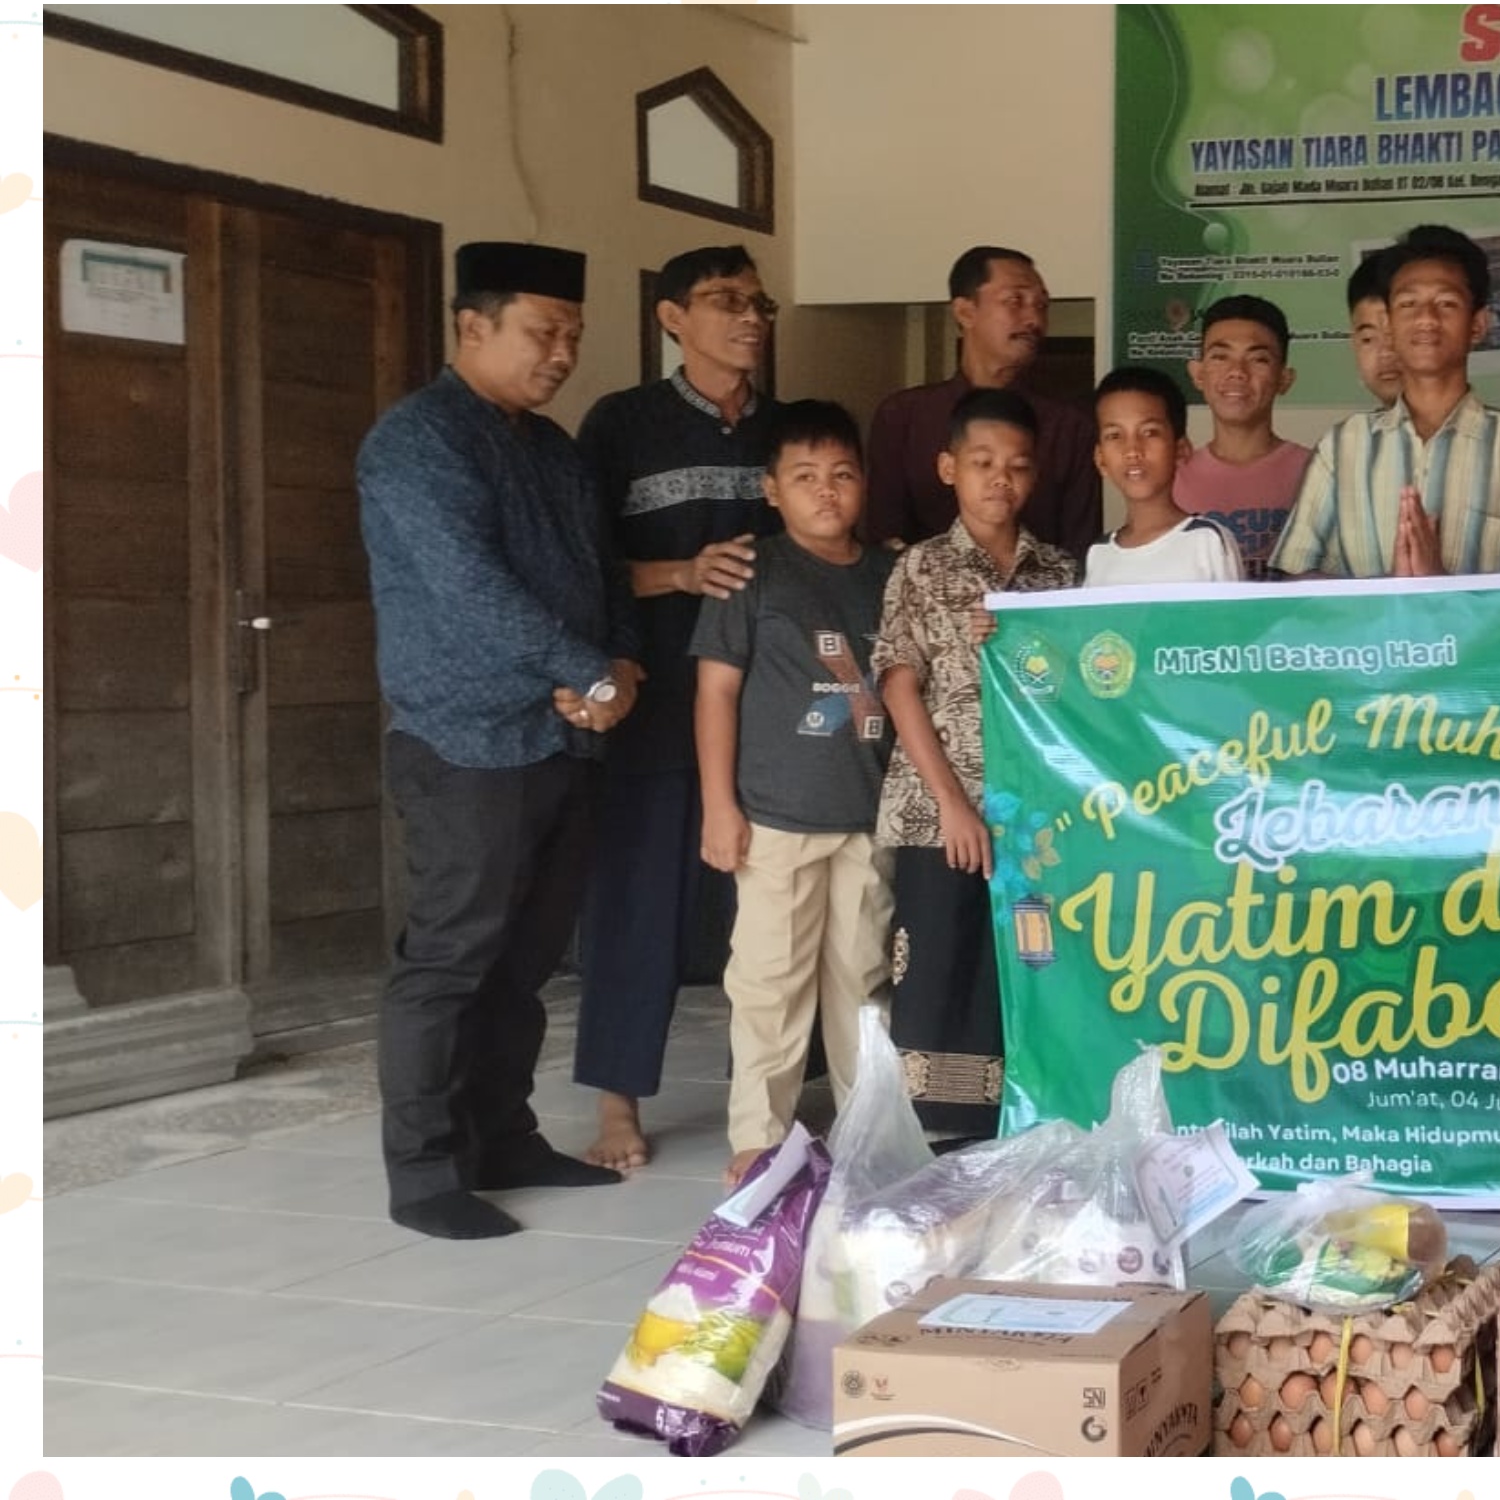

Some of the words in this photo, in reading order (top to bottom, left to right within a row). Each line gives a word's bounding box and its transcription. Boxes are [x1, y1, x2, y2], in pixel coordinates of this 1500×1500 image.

[1191, 138, 1293, 172] YAYASAN
[1302, 134, 1367, 168] TIARA
[1378, 130, 1463, 165] BHAKTI
[1154, 646, 1241, 675] MTsN
[1245, 645, 1262, 673] 1
[1266, 642, 1380, 674] Batang
[1387, 634, 1458, 669] Hari
[1059, 858, 1415, 1013] Yatim
[1332, 1060, 1368, 1085] 08
[1450, 1090, 1479, 1109] 04
[1268, 1124, 1338, 1145] Yatim,
[1342, 1124, 1400, 1143] Maka
[1299, 1153, 1339, 1172] dan
[1343, 1154, 1433, 1178] Bahagia
